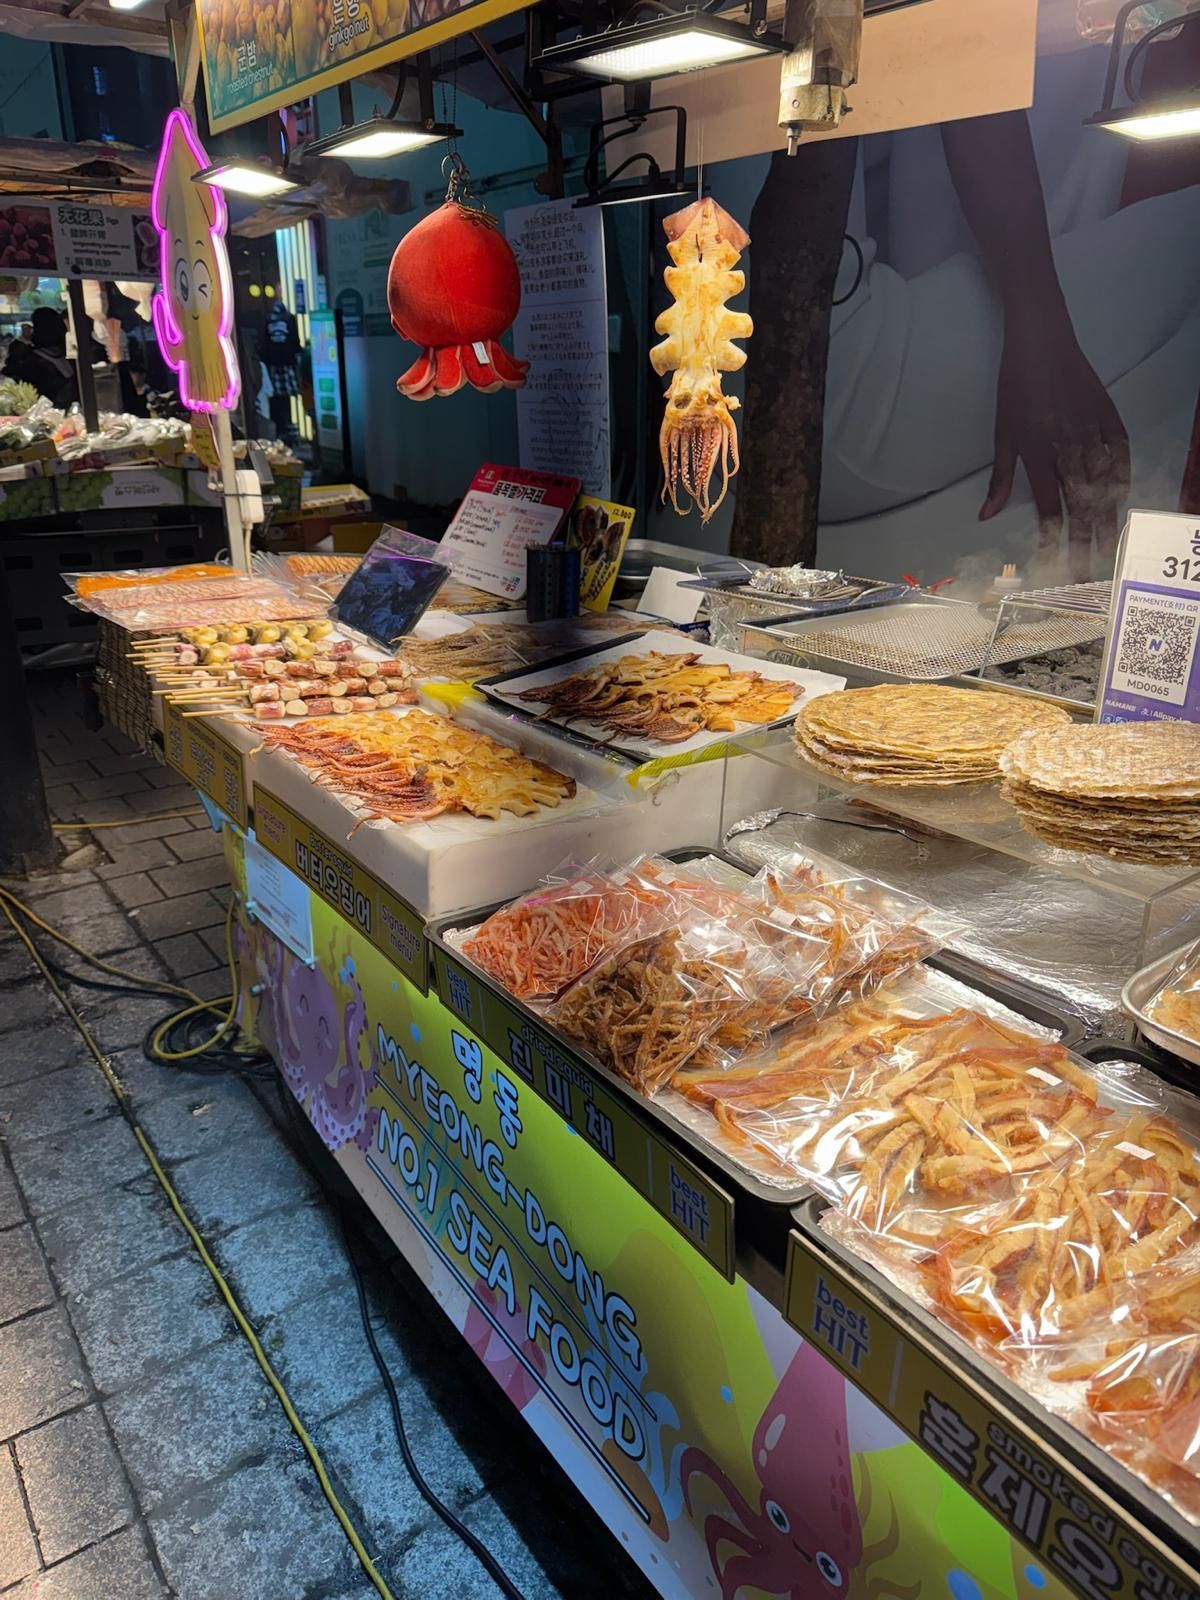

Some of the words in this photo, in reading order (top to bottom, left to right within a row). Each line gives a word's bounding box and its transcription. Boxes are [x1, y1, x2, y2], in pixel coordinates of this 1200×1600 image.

[237, 40, 257, 72] 군밤
[328, 22, 355, 52] ginkgo
[352, 12, 370, 38] nut
[248, 62, 274, 87] chestnut
[1186, 603, 1199, 613] QR
[1127, 679, 1170, 696] MD0065
[295, 839, 372, 934] 버터오징어
[381, 904, 421, 952] Signature
[390, 933, 412, 962] menu
[447, 965, 470, 996] best
[450, 983, 473, 1020] HIT
[520, 1024, 555, 1062] dried
[555, 1057, 594, 1100] squid
[376, 1022, 642, 1371] MYEONG-DONG
[670, 1164, 708, 1216] best
[671, 1189, 710, 1243] HIT
[377, 1106, 440, 1214] NO.1
[446, 1190, 517, 1316] SEA
[527, 1287, 646, 1461] FOOD
[816, 1277, 869, 1340] best
[813, 1306, 870, 1370] HIT
[986, 1421, 1121, 1545] smoked
